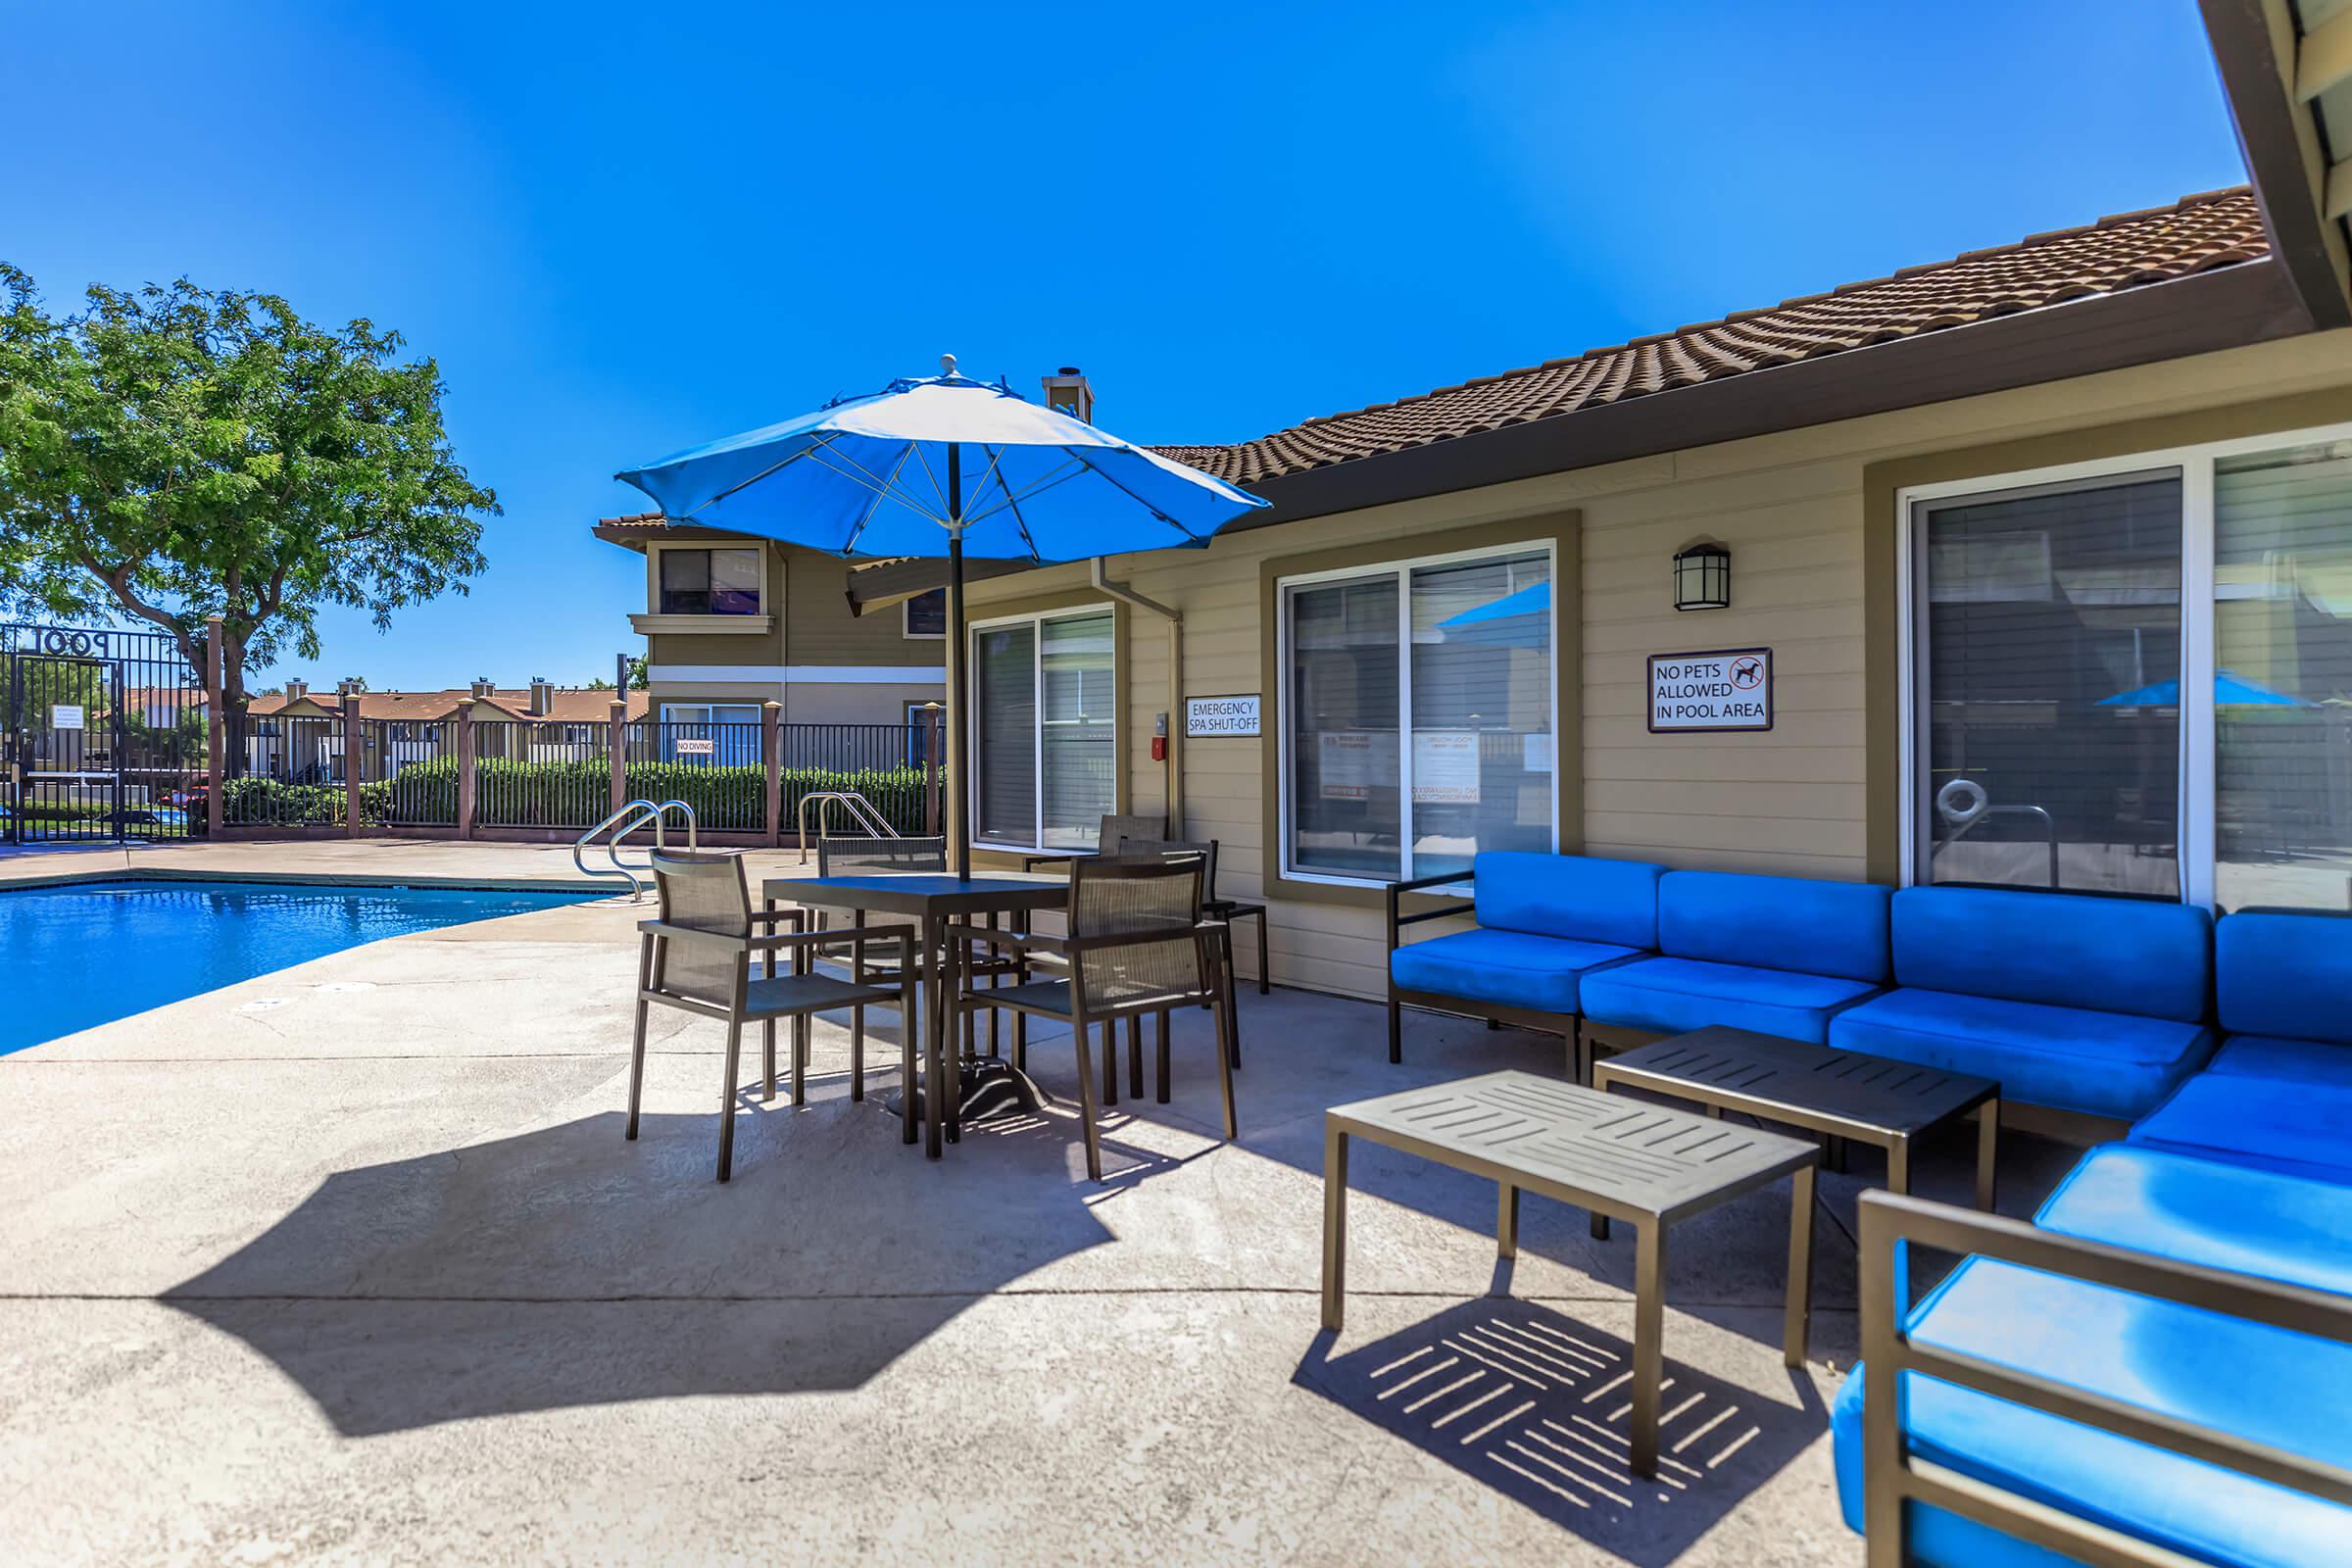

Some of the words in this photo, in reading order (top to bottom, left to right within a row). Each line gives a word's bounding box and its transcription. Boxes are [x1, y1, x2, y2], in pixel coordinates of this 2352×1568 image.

[1657, 666, 1681, 680] NO
[1684, 663, 1721, 679] PETS
[1656, 683, 1733, 699] ALLOWED
[1193, 702, 1254, 715] EMERGENCY
[1657, 706, 1672, 719] IN
[1676, 705, 1719, 718] POOL
[1722, 703, 1765, 717] AREA
[1189, 718, 1206, 731] SPA
[1208, 716, 1258, 731] SHUT-OFF
[678, 742, 688, 751] NO
[689, 742, 711, 751] DIVING
